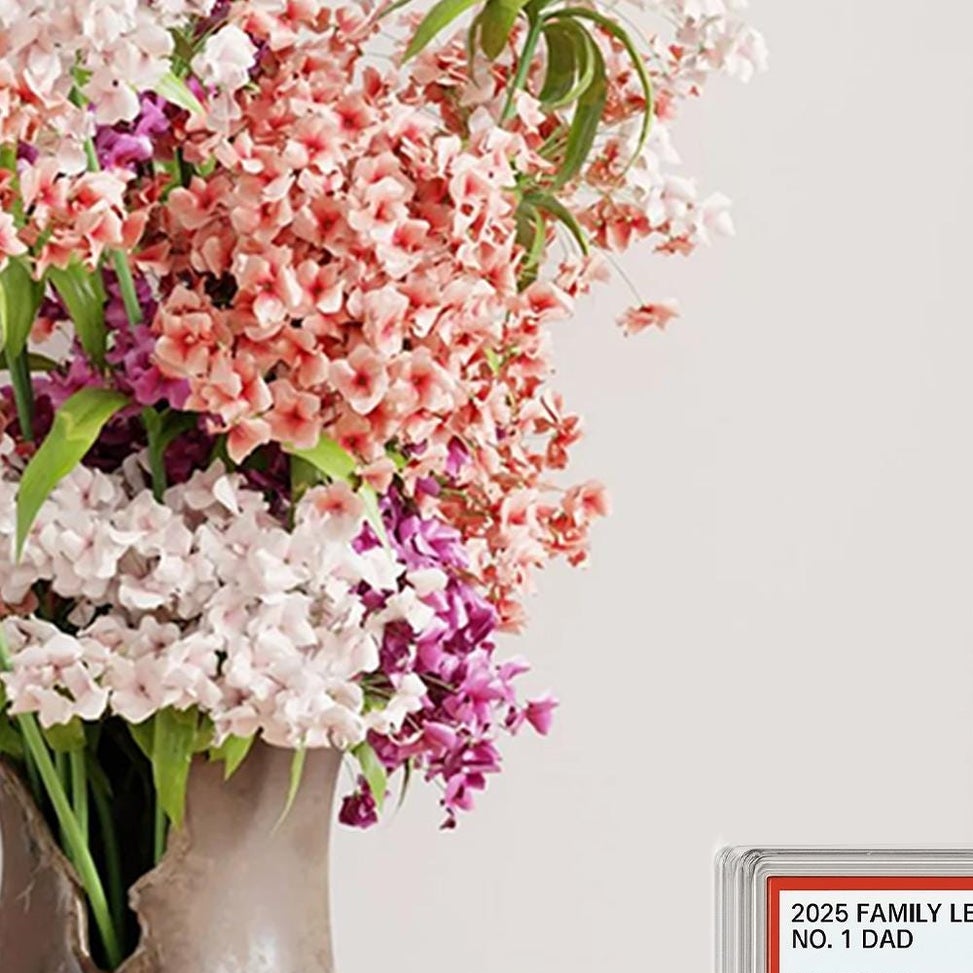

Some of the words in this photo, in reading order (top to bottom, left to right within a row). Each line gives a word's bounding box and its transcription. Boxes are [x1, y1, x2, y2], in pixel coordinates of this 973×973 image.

[792, 904, 848, 922] 2025
[858, 904, 941, 922] FAMILY
[793, 929, 832, 948] NO.
[840, 929, 850, 949] 1
[863, 930, 913, 948] DAD
